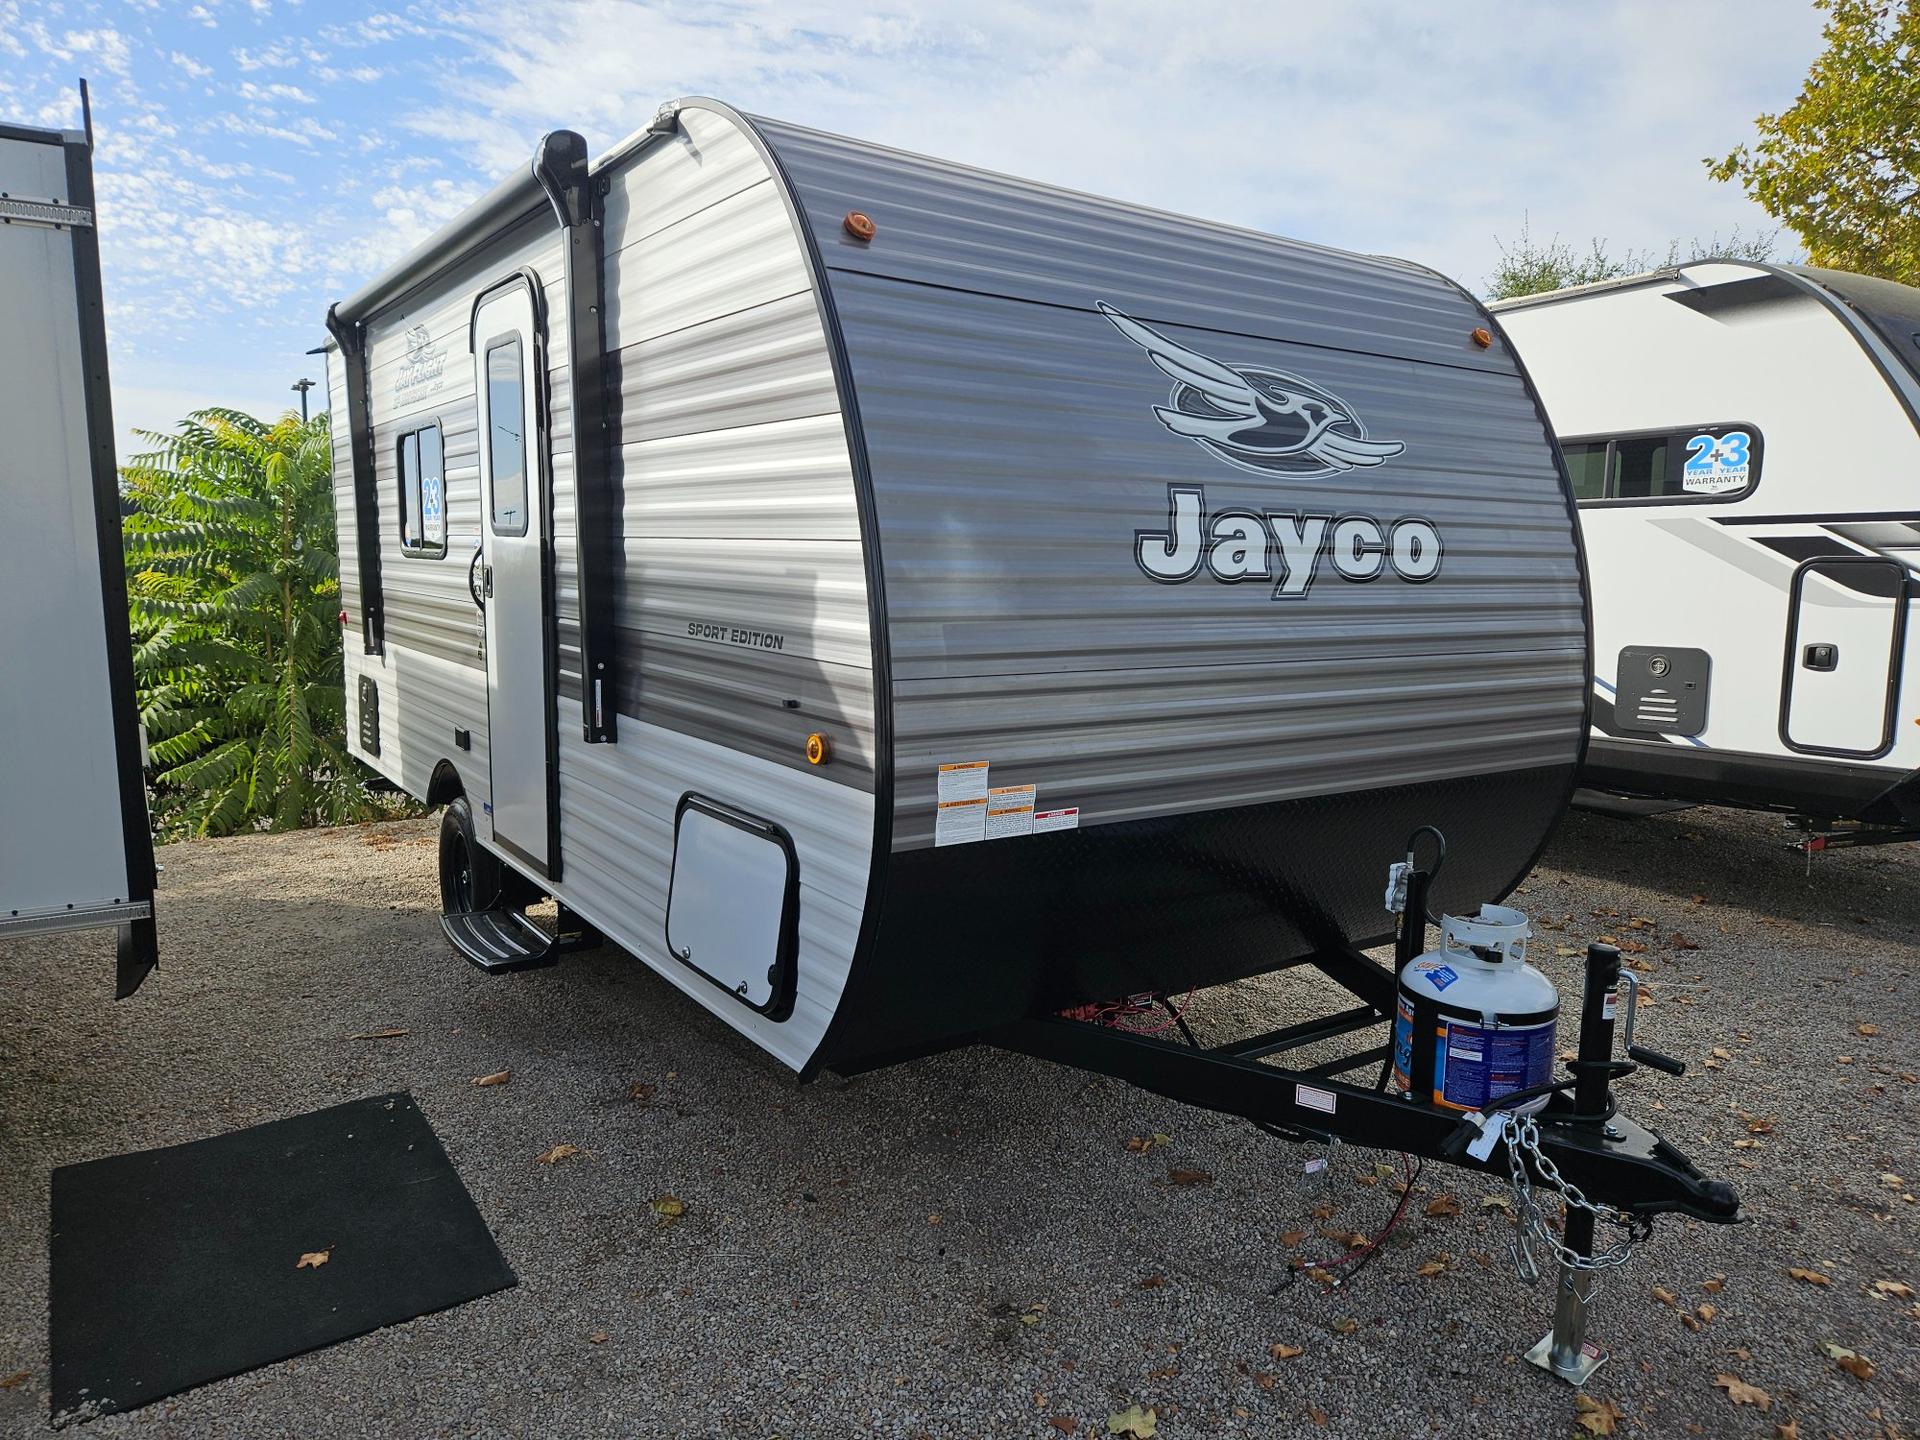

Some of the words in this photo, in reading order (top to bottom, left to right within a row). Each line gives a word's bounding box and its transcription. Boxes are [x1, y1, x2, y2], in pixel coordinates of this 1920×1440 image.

[1685, 476, 1746, 486] WARRANTY
[1134, 484, 1444, 601] Jayco
[687, 622, 728, 640] SPORT
[731, 629, 784, 650] EDITION
